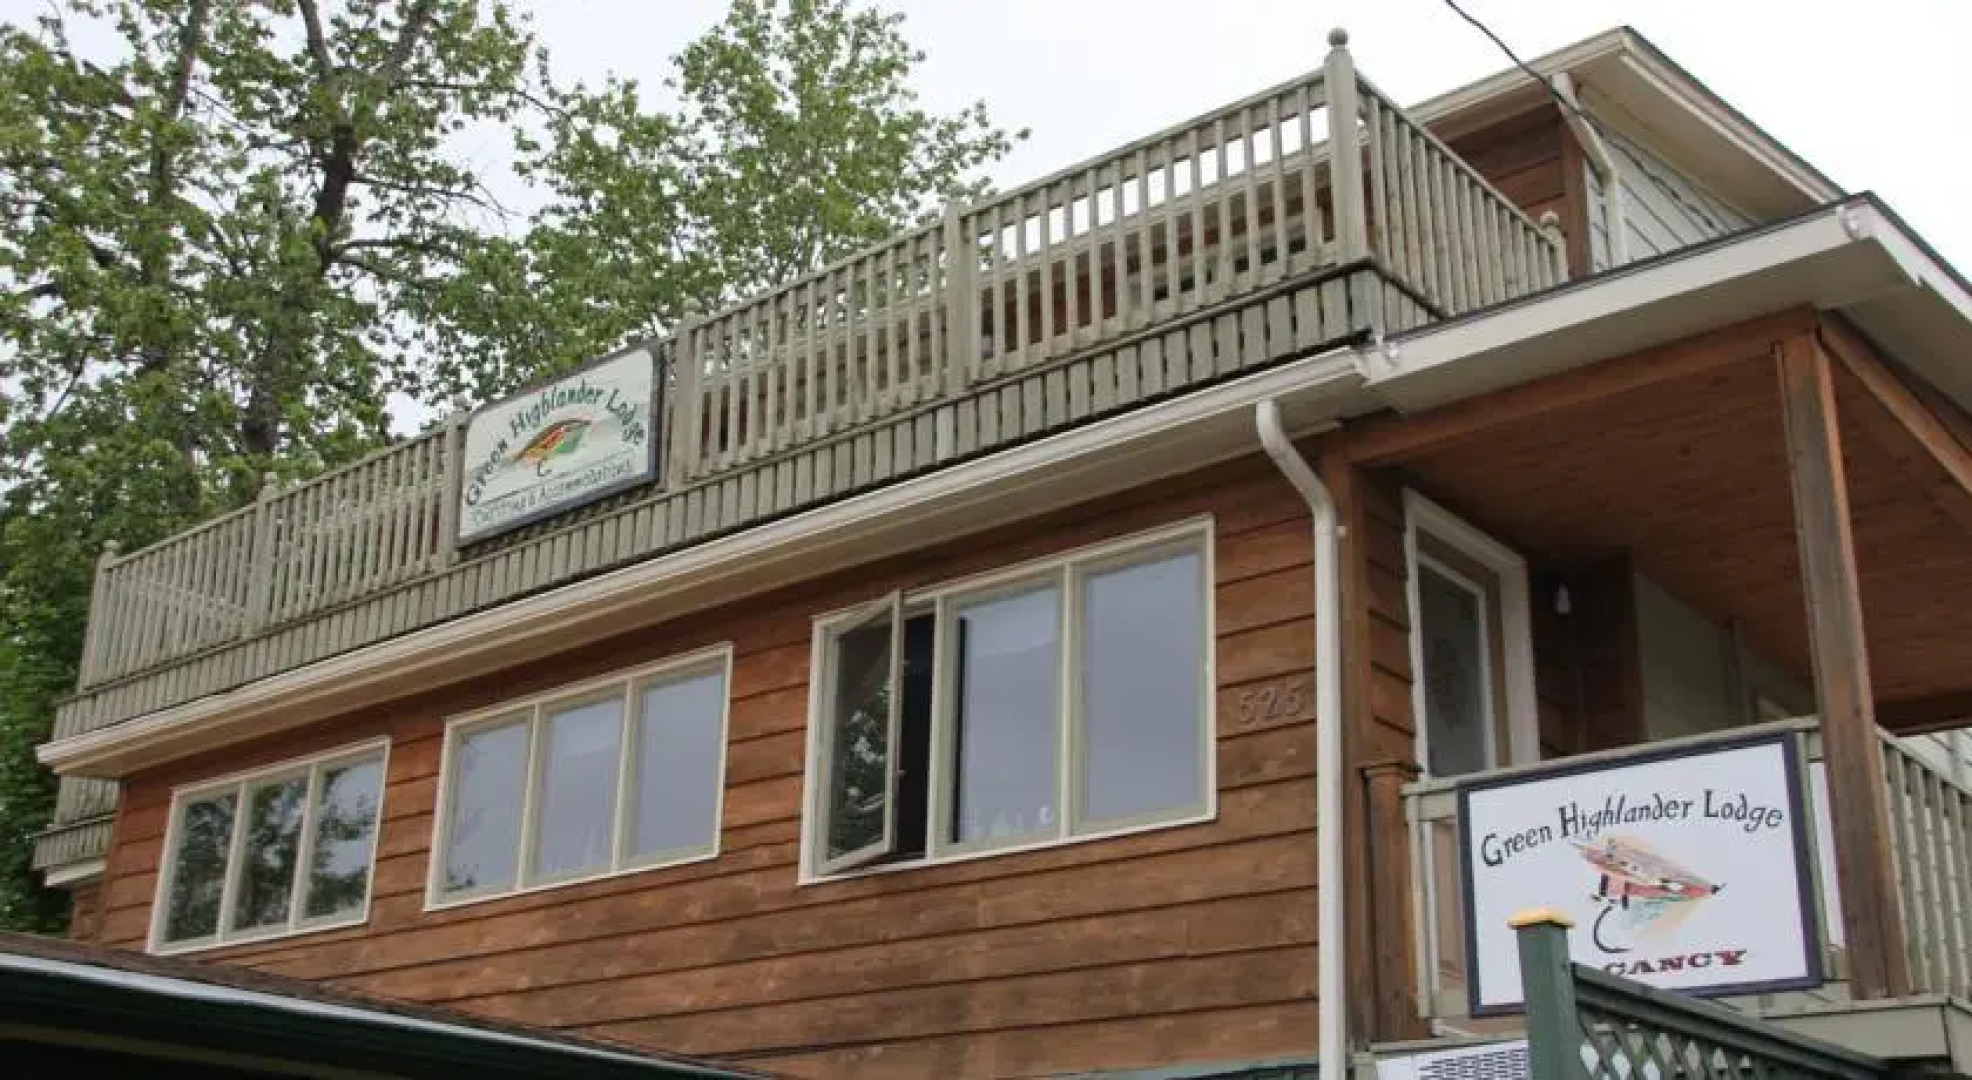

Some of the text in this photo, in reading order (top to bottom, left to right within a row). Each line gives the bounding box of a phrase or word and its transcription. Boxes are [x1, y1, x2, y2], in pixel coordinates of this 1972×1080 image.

[467, 378, 644, 505] Green Highlander Lodge
[1238, 684, 1307, 726] 525
[1480, 788, 1784, 867] Green Highlander Lodge
[1604, 948, 1748, 976] CANCY
